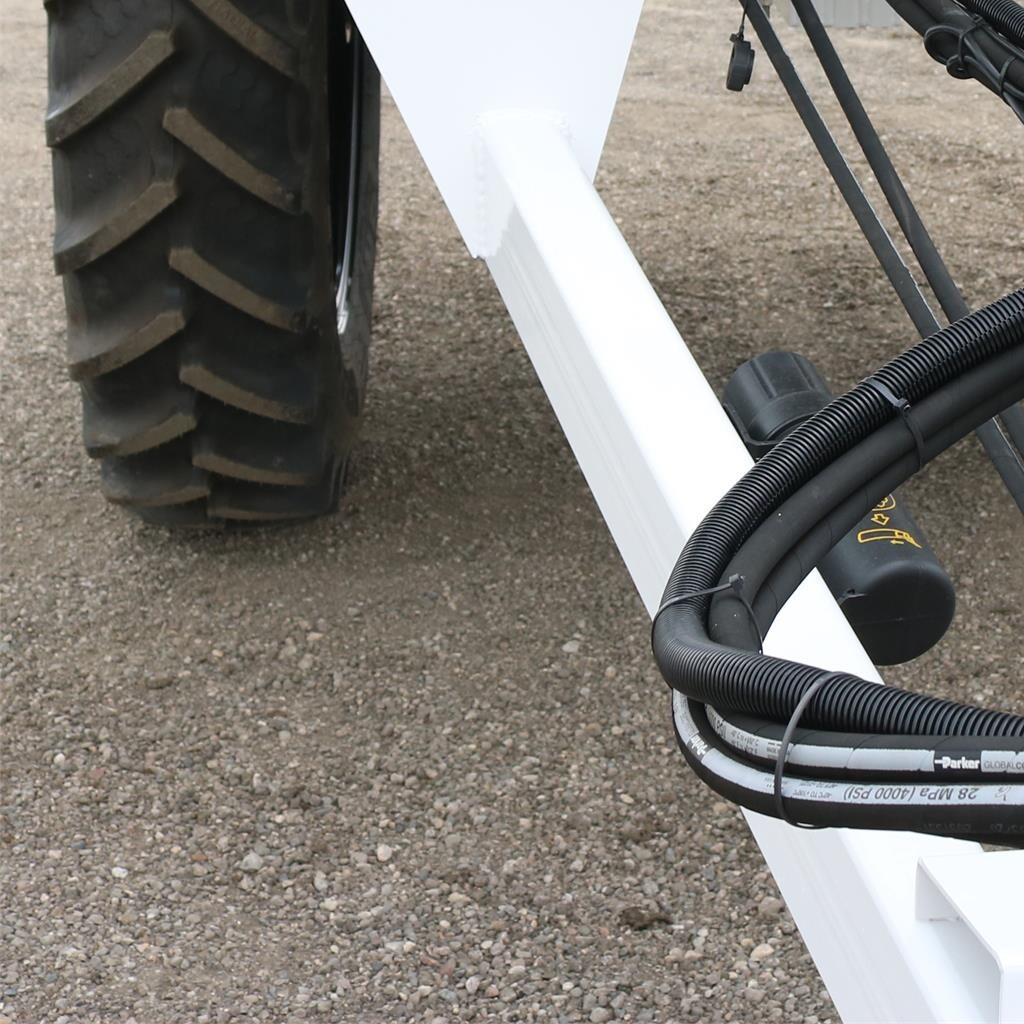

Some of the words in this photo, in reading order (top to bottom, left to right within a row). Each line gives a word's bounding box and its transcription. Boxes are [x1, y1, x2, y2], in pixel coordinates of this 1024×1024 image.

[941, 756, 980, 769] Parker
[843, 786, 871, 801] PSI)
[875, 786, 917, 801] (4000
[920, 787, 952, 800] MPa
[958, 787, 979, 800] 28
